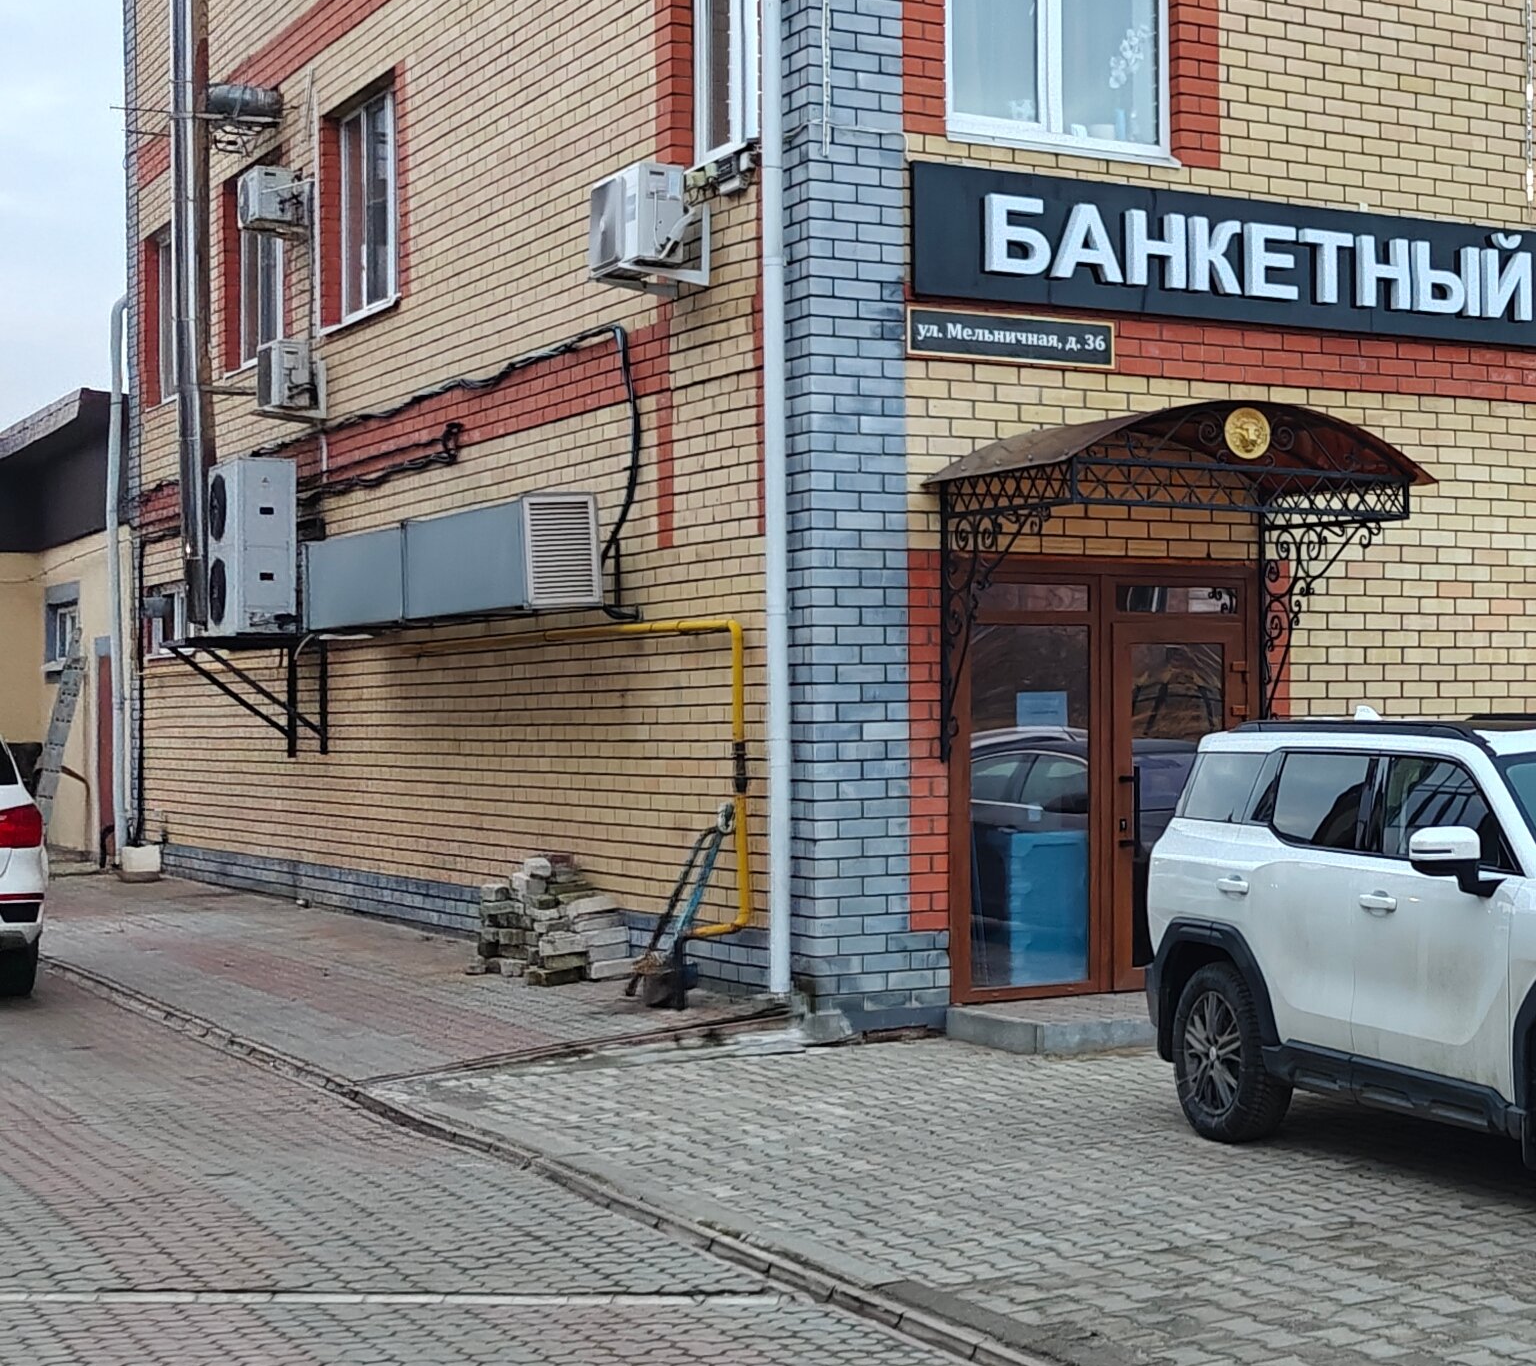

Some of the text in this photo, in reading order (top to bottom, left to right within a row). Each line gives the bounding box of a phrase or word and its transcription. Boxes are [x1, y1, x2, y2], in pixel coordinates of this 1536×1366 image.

[983, 193, 1533, 322] БАНКЕТНЫЙ
[917, 323, 1106, 352] ул. Мельничная, д. 36
